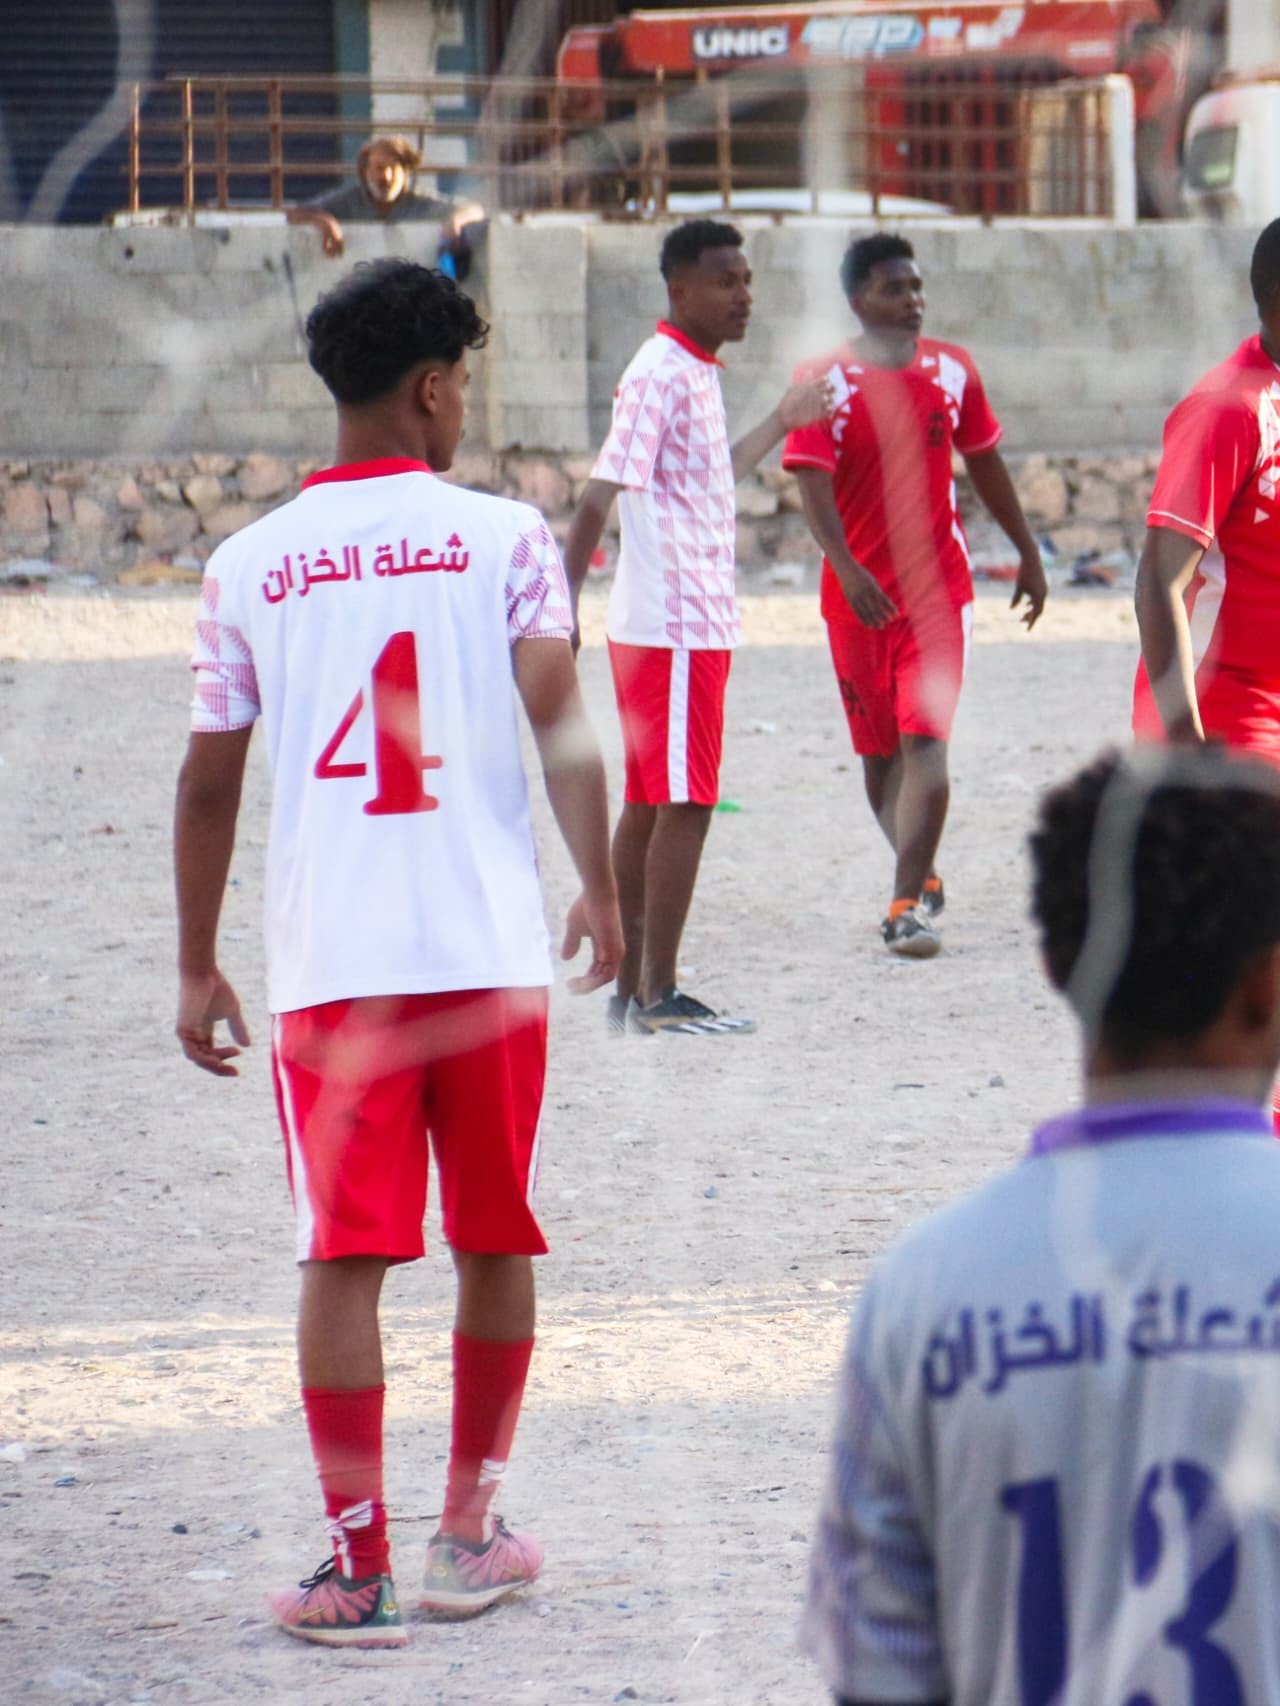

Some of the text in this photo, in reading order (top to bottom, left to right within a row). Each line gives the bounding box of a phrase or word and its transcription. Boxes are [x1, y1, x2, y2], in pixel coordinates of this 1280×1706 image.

[693, 27, 788, 58] UNIC
[262, 533, 470, 603] شعلة الخزان
[314, 631, 443, 816] 4
[922, 1293, 1107, 1398] الخزان
